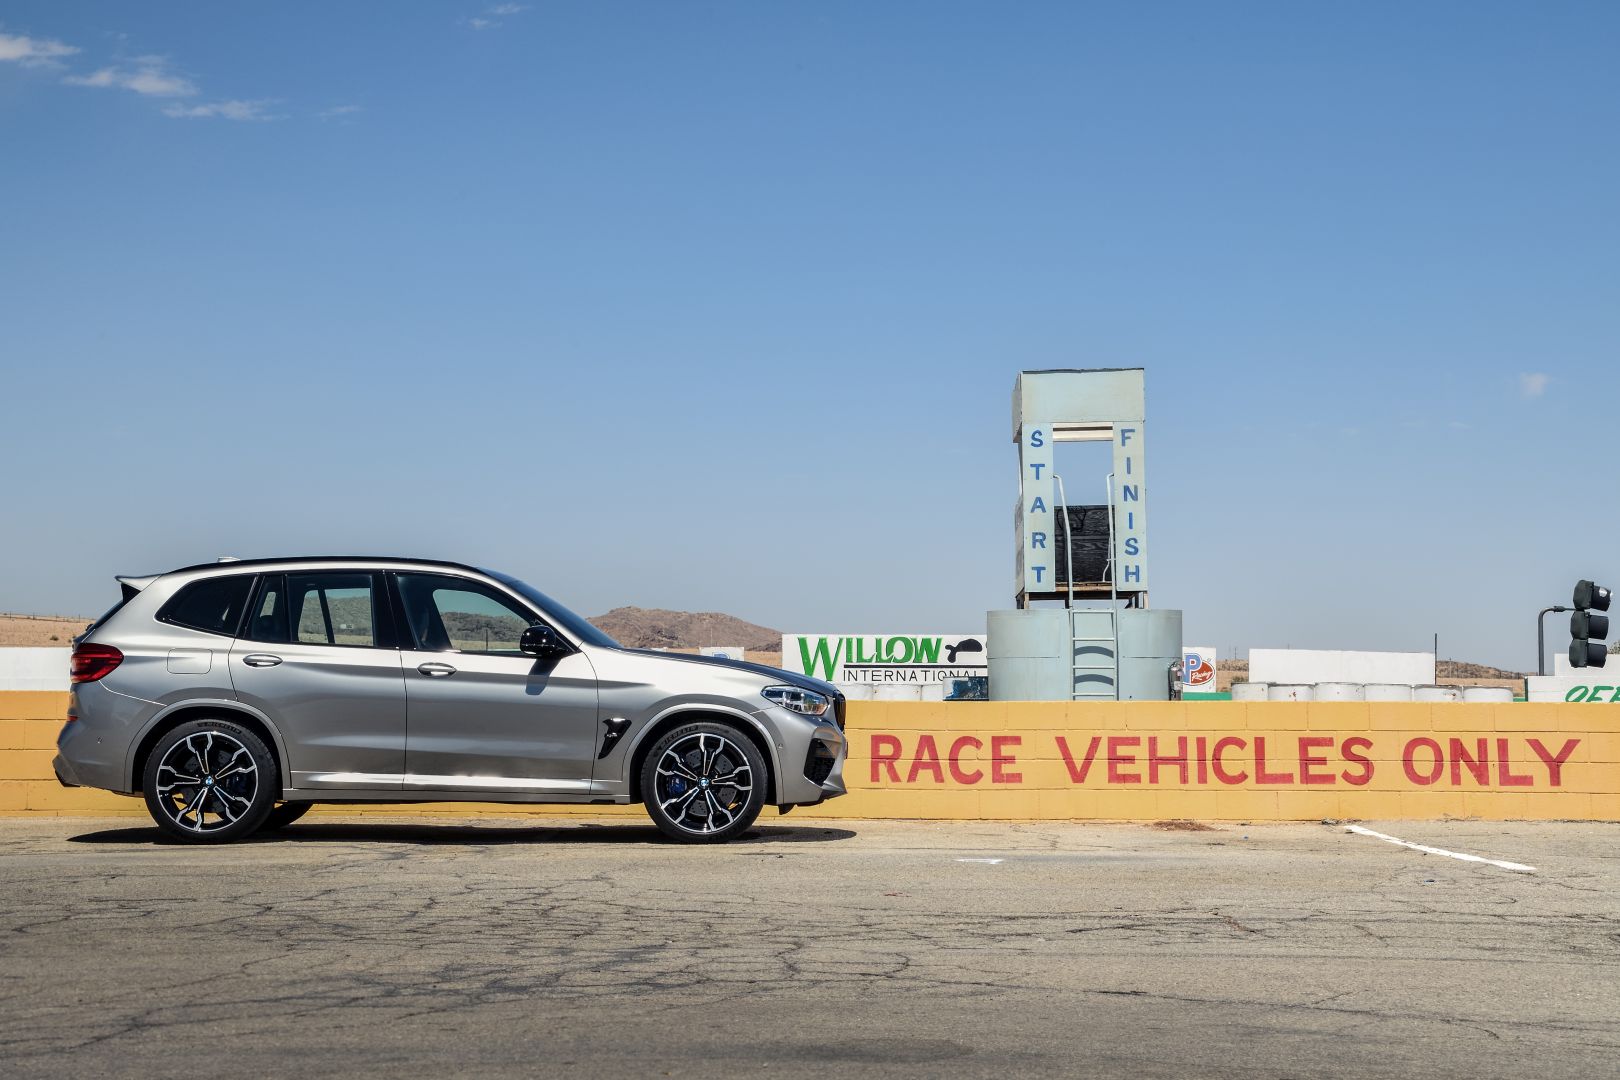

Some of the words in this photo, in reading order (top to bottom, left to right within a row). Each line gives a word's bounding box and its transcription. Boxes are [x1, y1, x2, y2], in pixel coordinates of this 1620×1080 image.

[1029, 429, 1047, 584] START
[1120, 428, 1141, 583] FINISH
[797, 636, 943, 682] WILLOW
[1565, 685, 1620, 702] OF
[870, 734, 1022, 785] RACE
[1055, 735, 1374, 786] VEHICLES
[1403, 737, 1581, 787] ONLY
